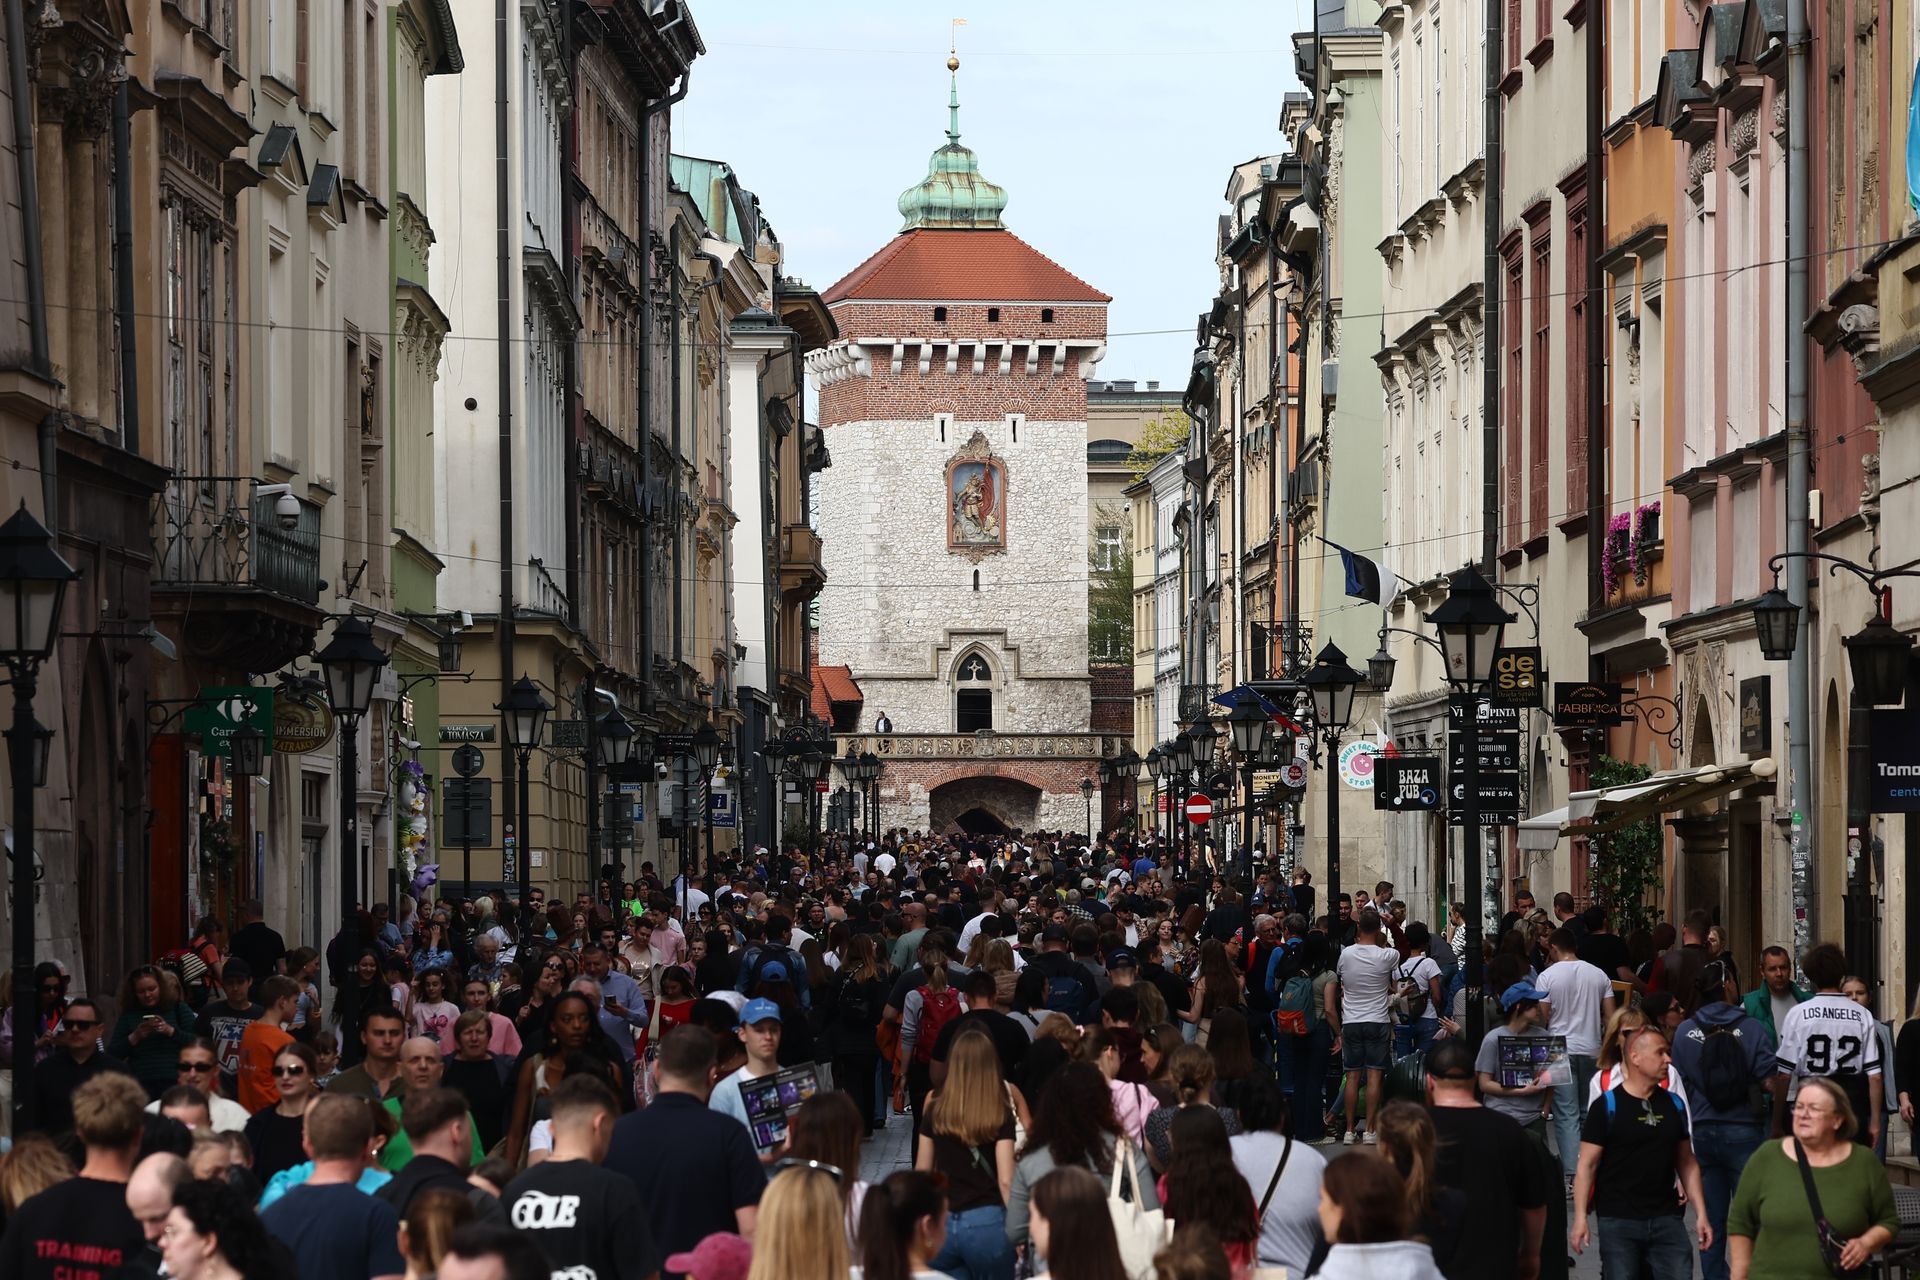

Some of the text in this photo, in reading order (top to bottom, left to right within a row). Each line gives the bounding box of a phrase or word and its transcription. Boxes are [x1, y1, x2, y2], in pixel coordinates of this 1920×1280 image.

[1497, 654, 1535, 673] de
[1499, 673, 1535, 689] sa
[1490, 708, 1516, 717] PINTA
[1558, 703, 1619, 714] FABBRICA
[276, 726, 327, 737] IMMERSION
[447, 731, 484, 740] TOMASZA
[1399, 769, 1430, 784] BAZA
[1399, 784, 1420, 799] PUB
[1890, 787, 1920, 797] cent
[1479, 813, 1501, 823] STEL
[1803, 1007, 1862, 1021] LOS ANGELES
[1806, 1034, 1862, 1074] 92
[34, 1239, 124, 1267] TRAINING
